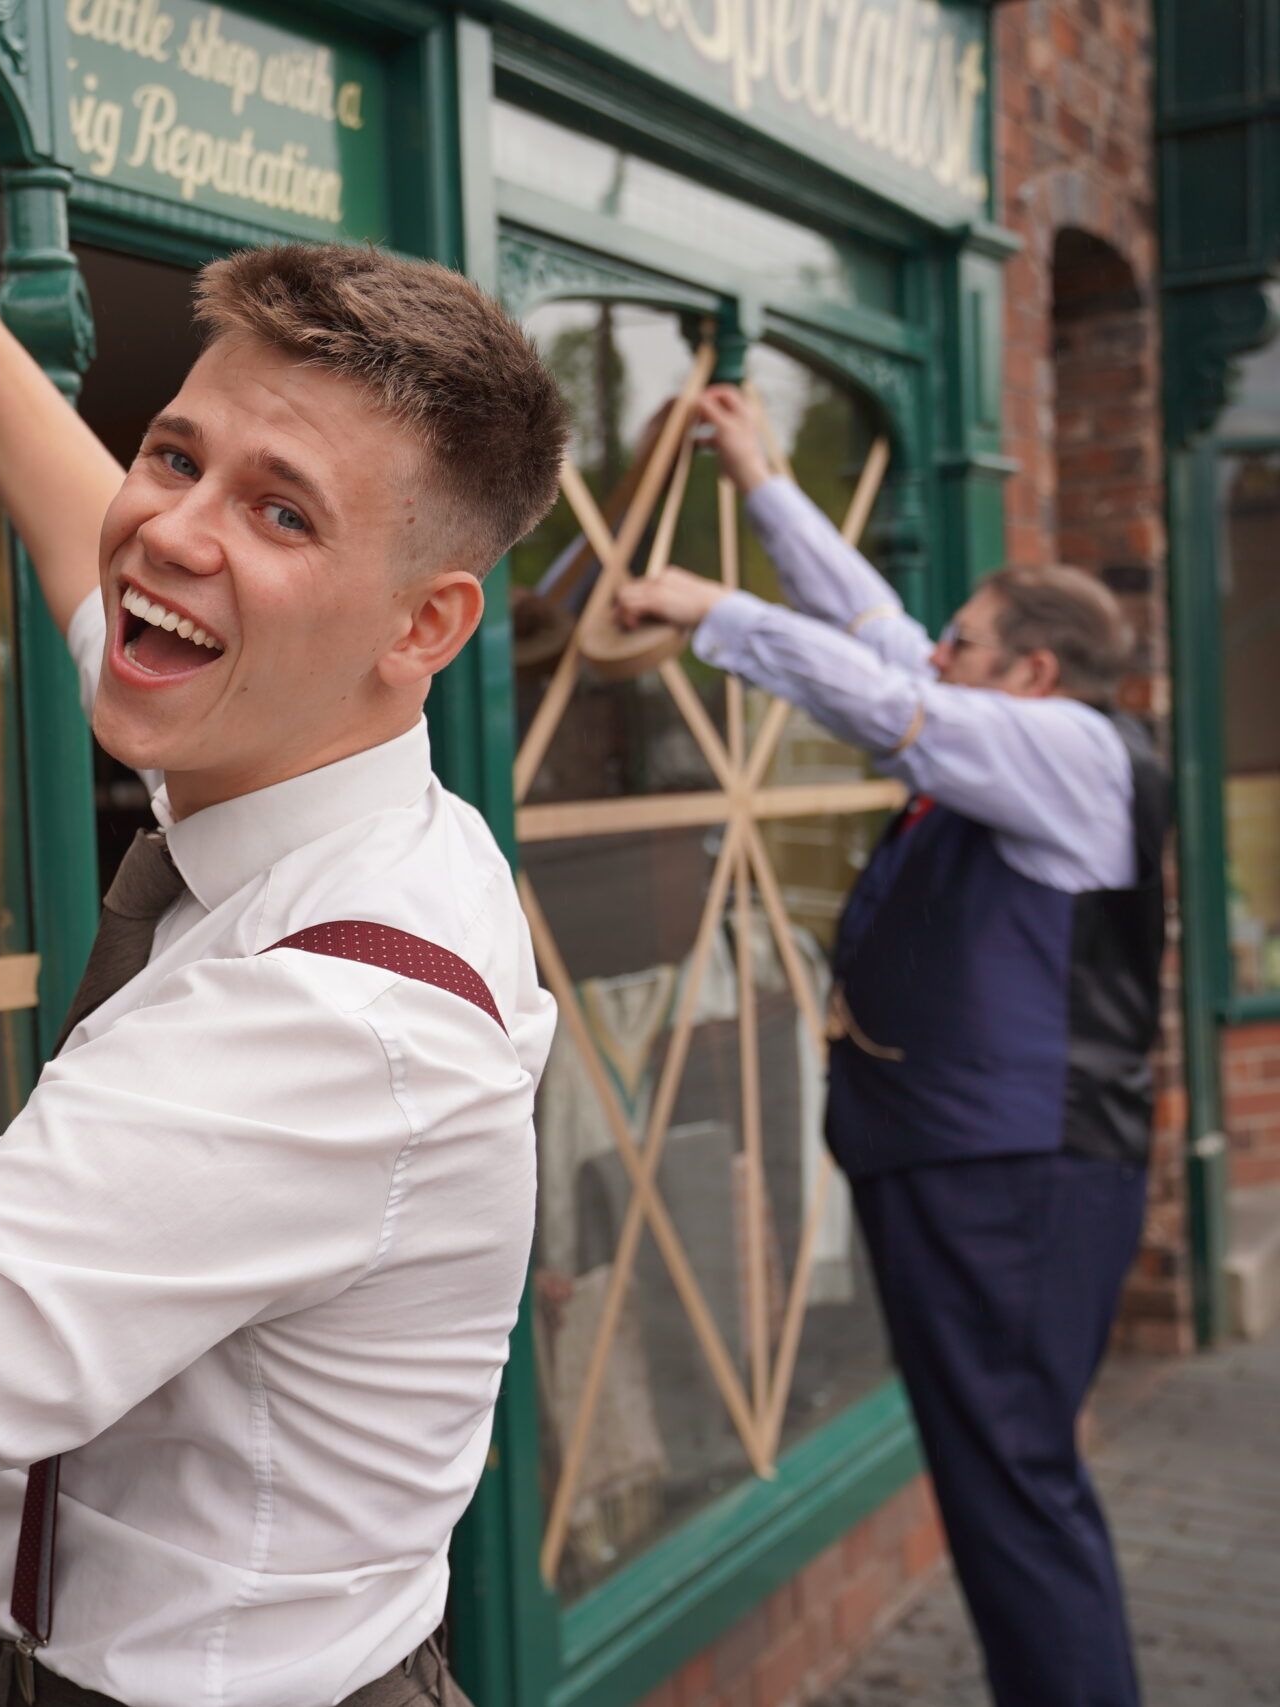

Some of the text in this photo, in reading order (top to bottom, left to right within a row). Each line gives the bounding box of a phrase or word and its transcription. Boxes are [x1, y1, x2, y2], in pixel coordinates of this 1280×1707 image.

[177, 7, 259, 115] shop
[260, 46, 337, 121] with
[337, 81, 365, 130] a
[126, 83, 344, 223] Reputation
